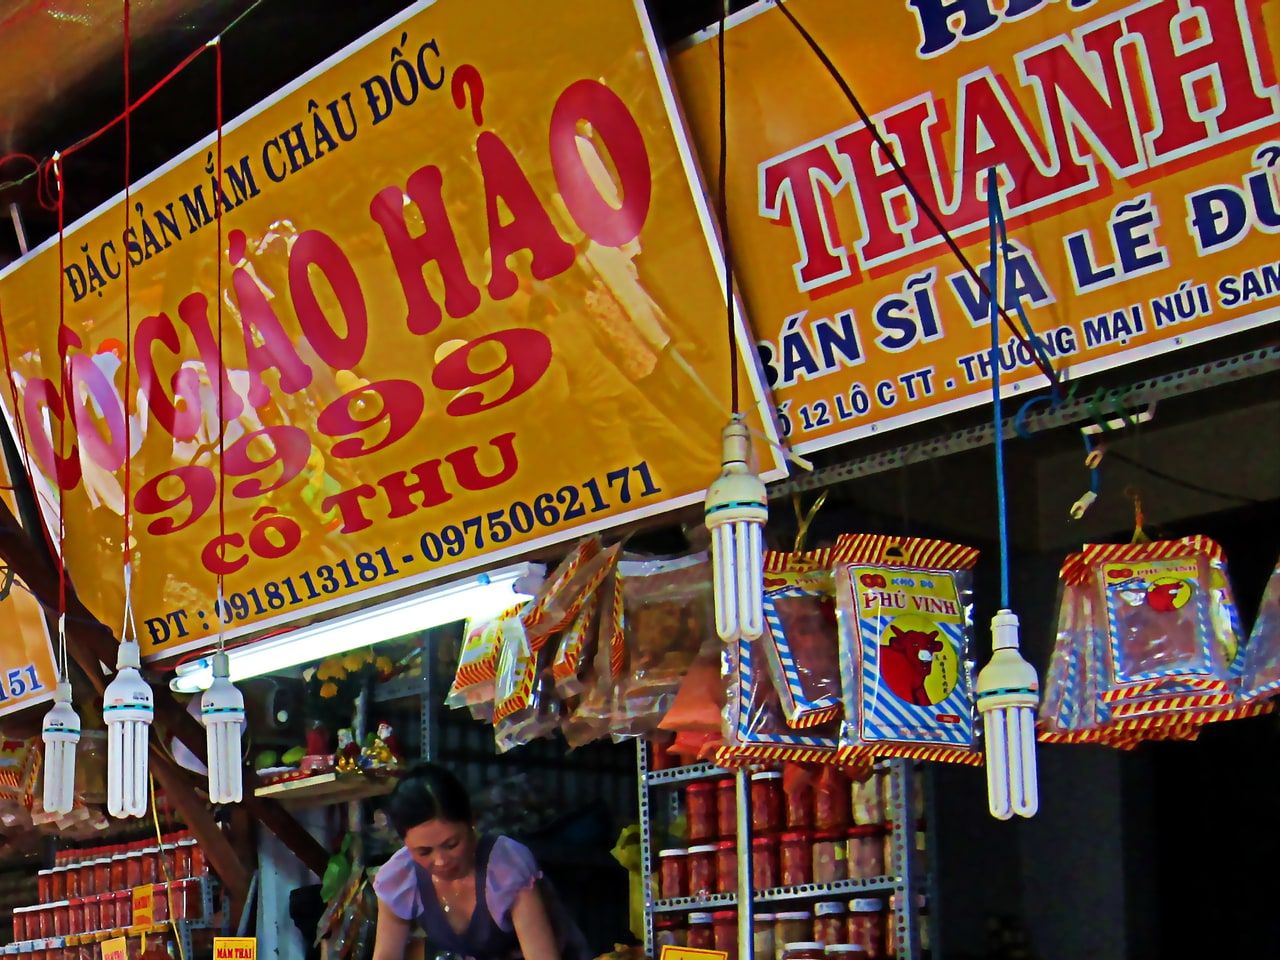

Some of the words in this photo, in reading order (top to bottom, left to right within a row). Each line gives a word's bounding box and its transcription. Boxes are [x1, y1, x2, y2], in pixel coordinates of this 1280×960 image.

[63, 243, 122, 303] ĐẶC
[122, 194, 183, 268] SẢN
[187, 150, 261, 238] MẮM
[261, 100, 360, 184] CHÂU
[366, 33, 448, 128] ĐỐC
[133, 229, 370, 443] GIÁO
[369, 64, 653, 338] HẢO
[800, 402, 832, 434] 12
[836, 385, 871, 423] LÔ
[876, 379, 897, 408] C
[899, 367, 933, 398] TT
[1084, 306, 1146, 347] MẠI
[1152, 280, 1212, 328] NÚI
[874, 267, 942, 352] SĨ
[953, 243, 1054, 326] VÀ
[1064, 194, 1169, 294] LẼ
[133, 327, 554, 538] 9999
[201, 506, 302, 577] CÔ
[321, 432, 520, 536] THU
[144, 609, 188, 647] ĐT
[419, 461, 664, 565] 0975062171
[863, 590, 907, 610] PHÚ
[912, 595, 959, 616] VINH
